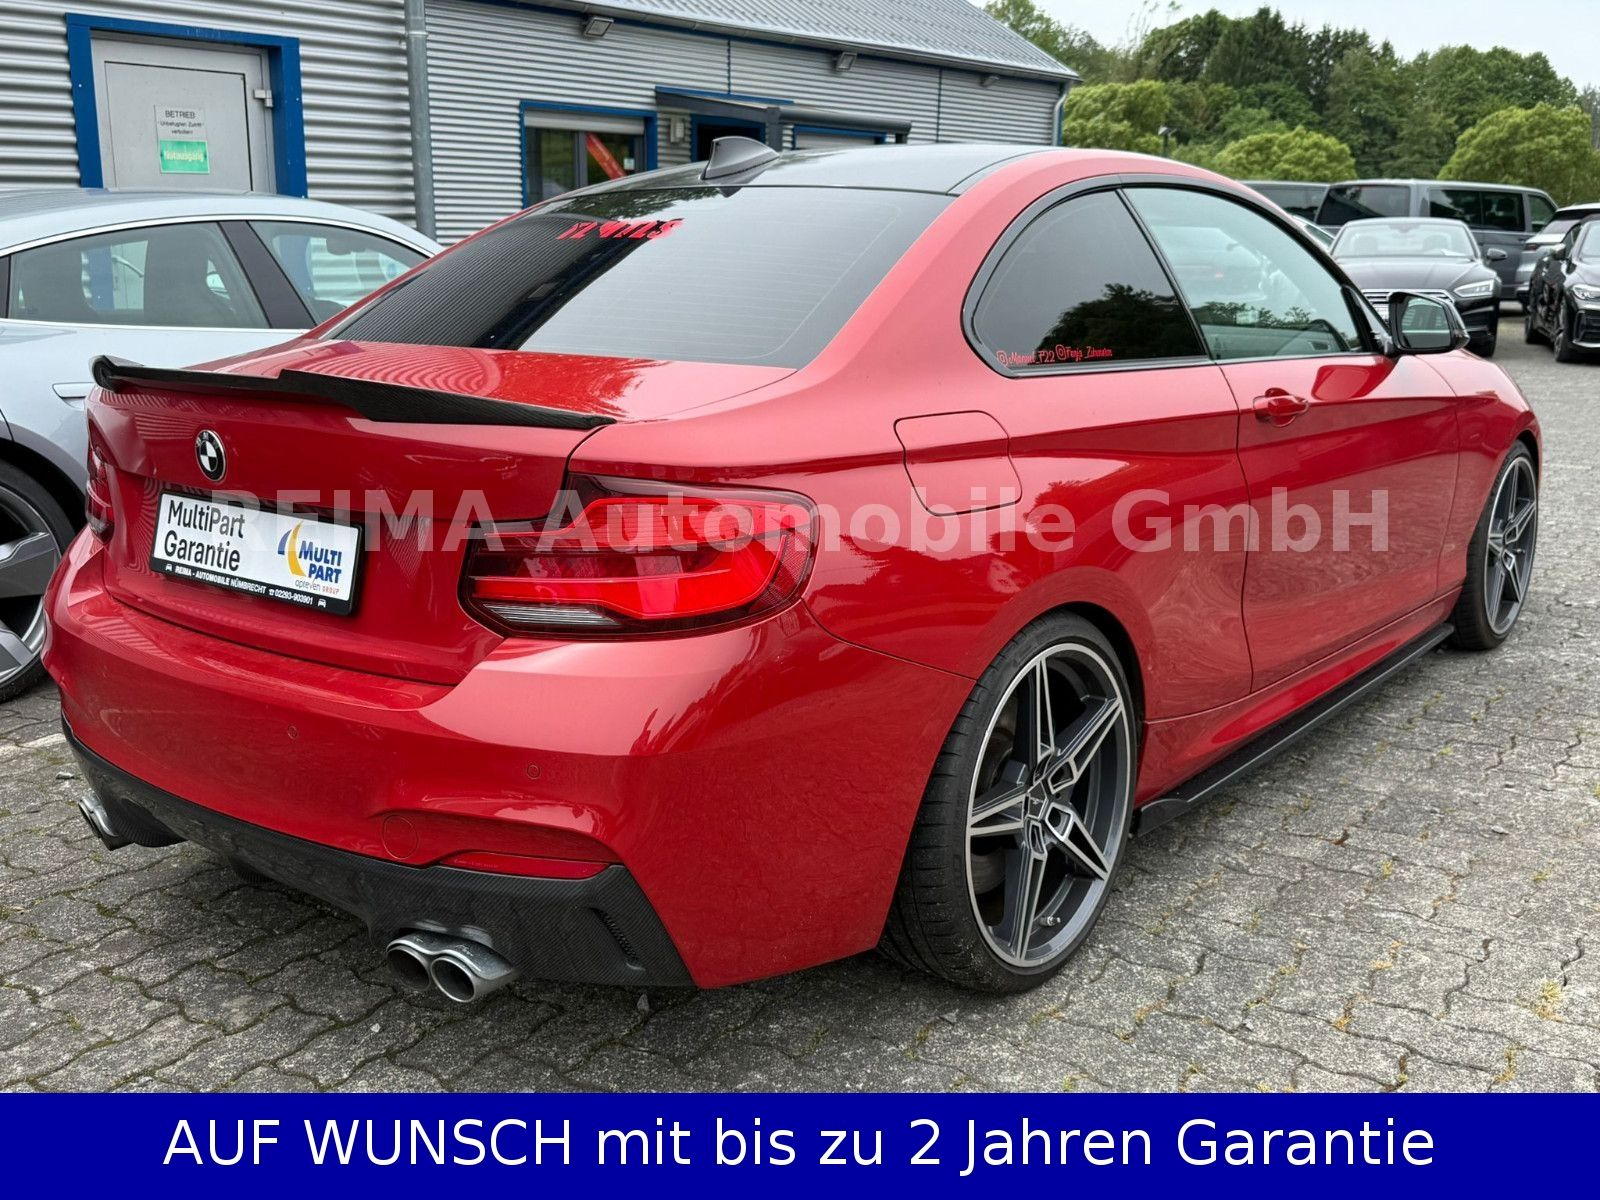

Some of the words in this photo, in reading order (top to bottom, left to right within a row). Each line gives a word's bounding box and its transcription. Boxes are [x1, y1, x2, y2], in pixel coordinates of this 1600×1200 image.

[165, 110, 196, 119] BETRIEB
[167, 499, 246, 539] MultiPart
[164, 529, 241, 572] Garantie
[298, 540, 343, 567] MULTI
[195, 570, 230, 586] AUTOMOBILE
[308, 563, 342, 584] PART
